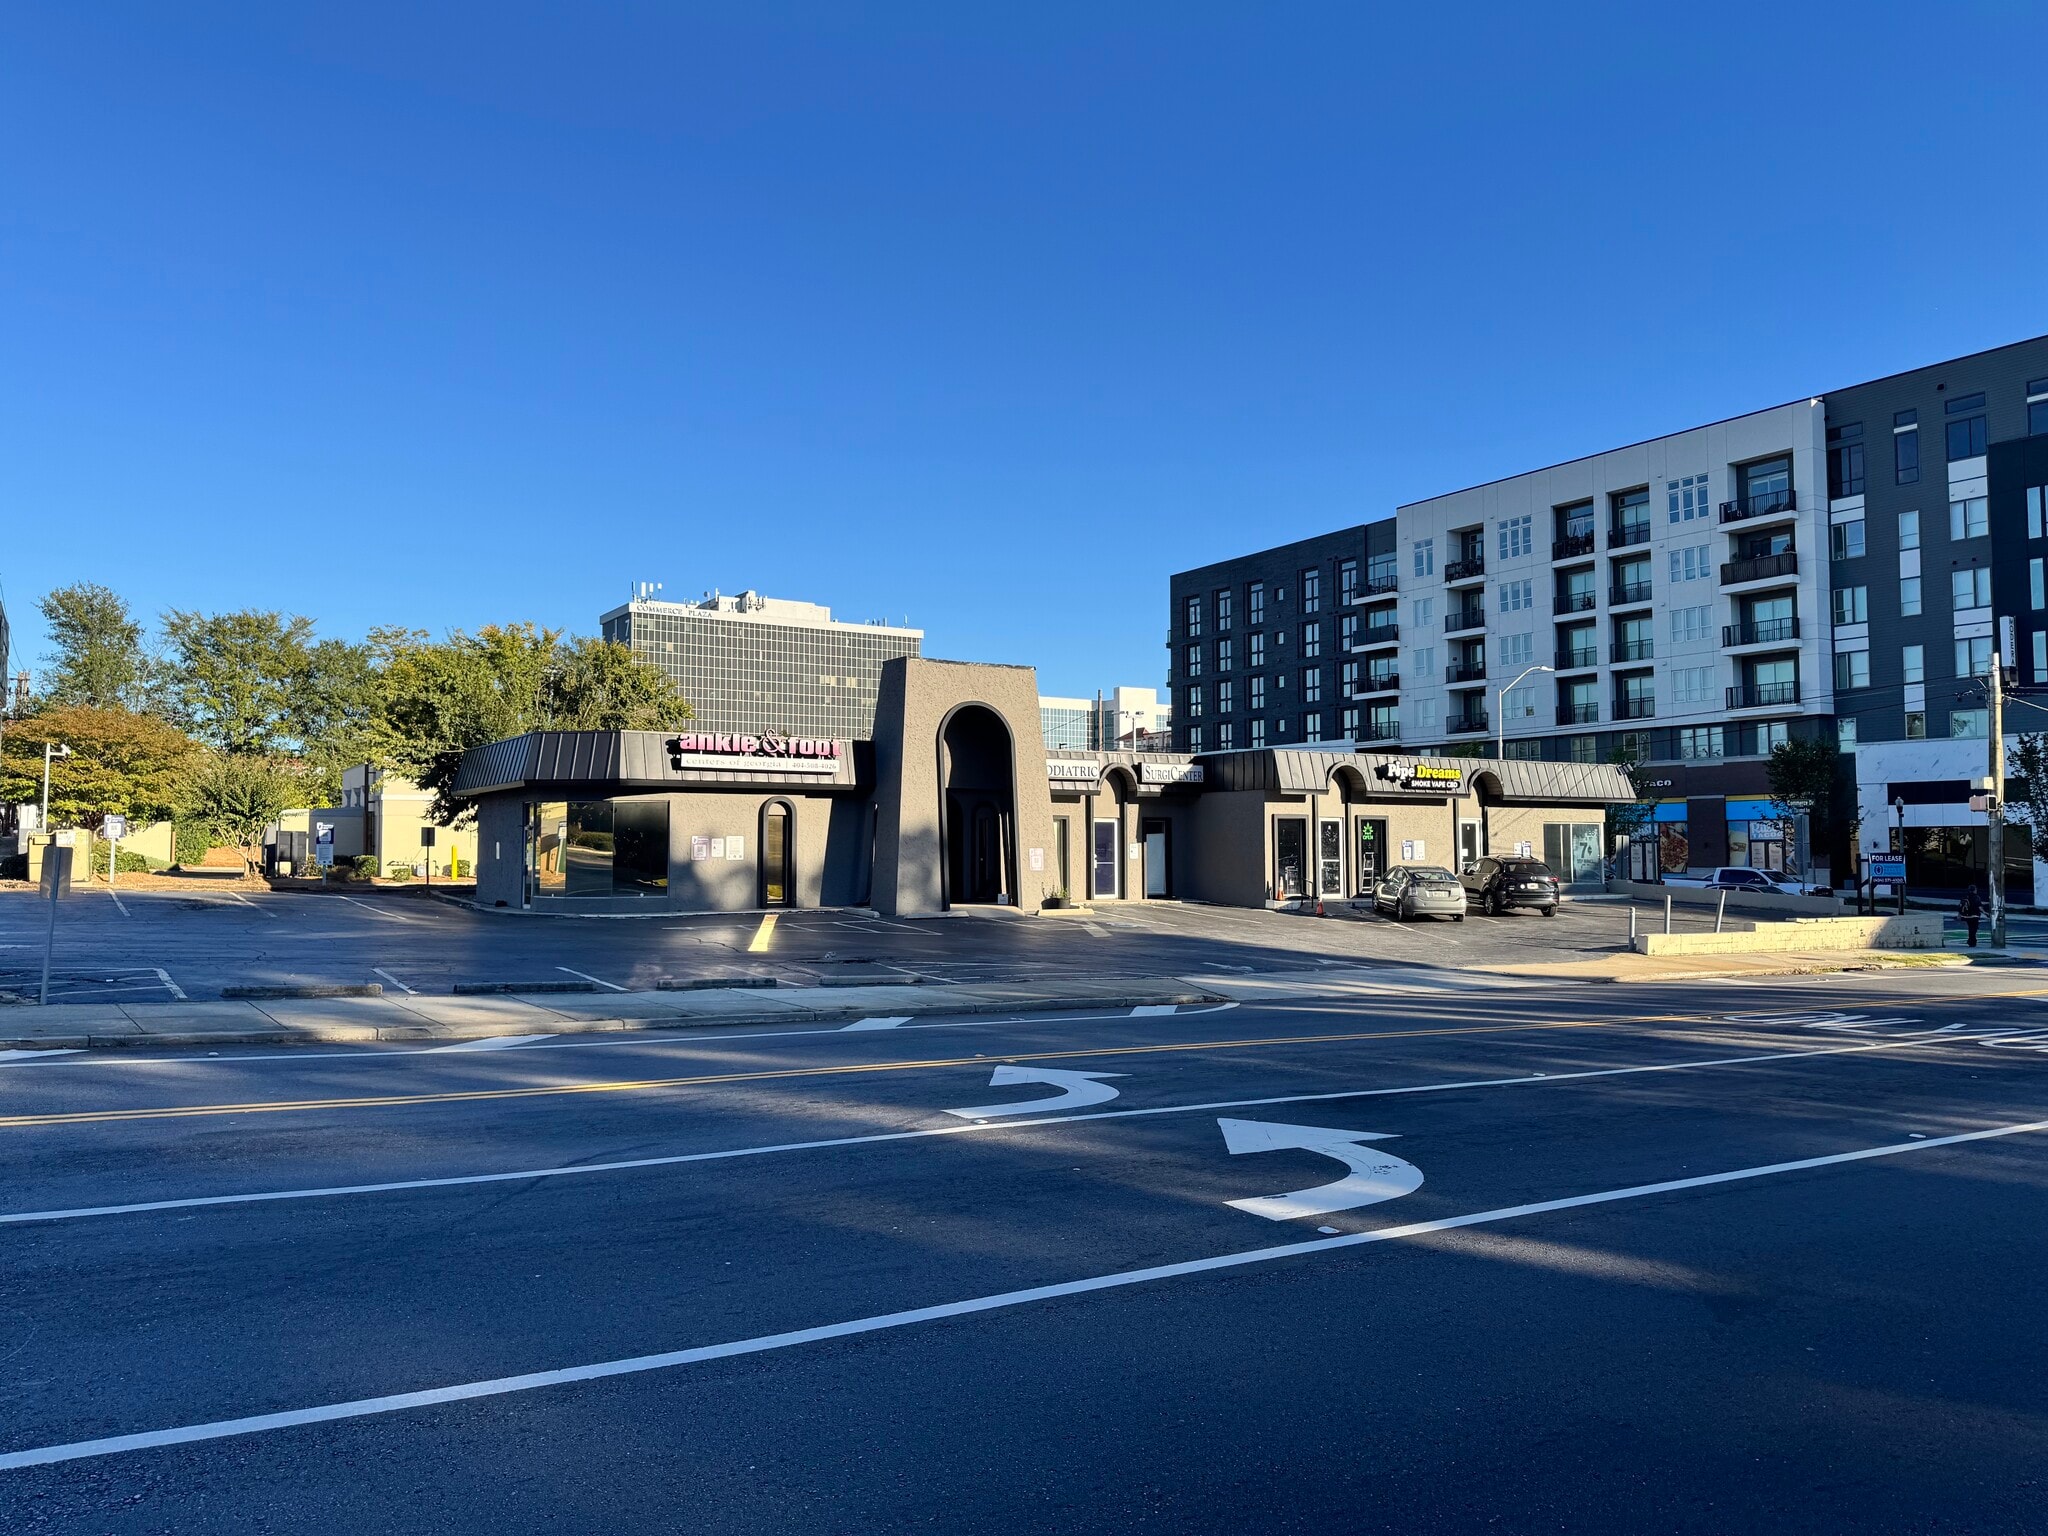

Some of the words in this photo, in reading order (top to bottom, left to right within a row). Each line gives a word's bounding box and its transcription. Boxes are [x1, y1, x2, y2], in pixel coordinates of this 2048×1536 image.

[637, 605, 683, 615] COMMERCE
[688, 610, 713, 618] PLAZA
[680, 733, 757, 752] ankle
[762, 728, 786, 754] &
[788, 737, 842, 756] foot
[743, 760, 782, 768] georgia
[1388, 761, 1415, 780] Pipe
[1416, 765, 1461, 779] Dreams
[1723, 1011, 2021, 1037] ONLY
